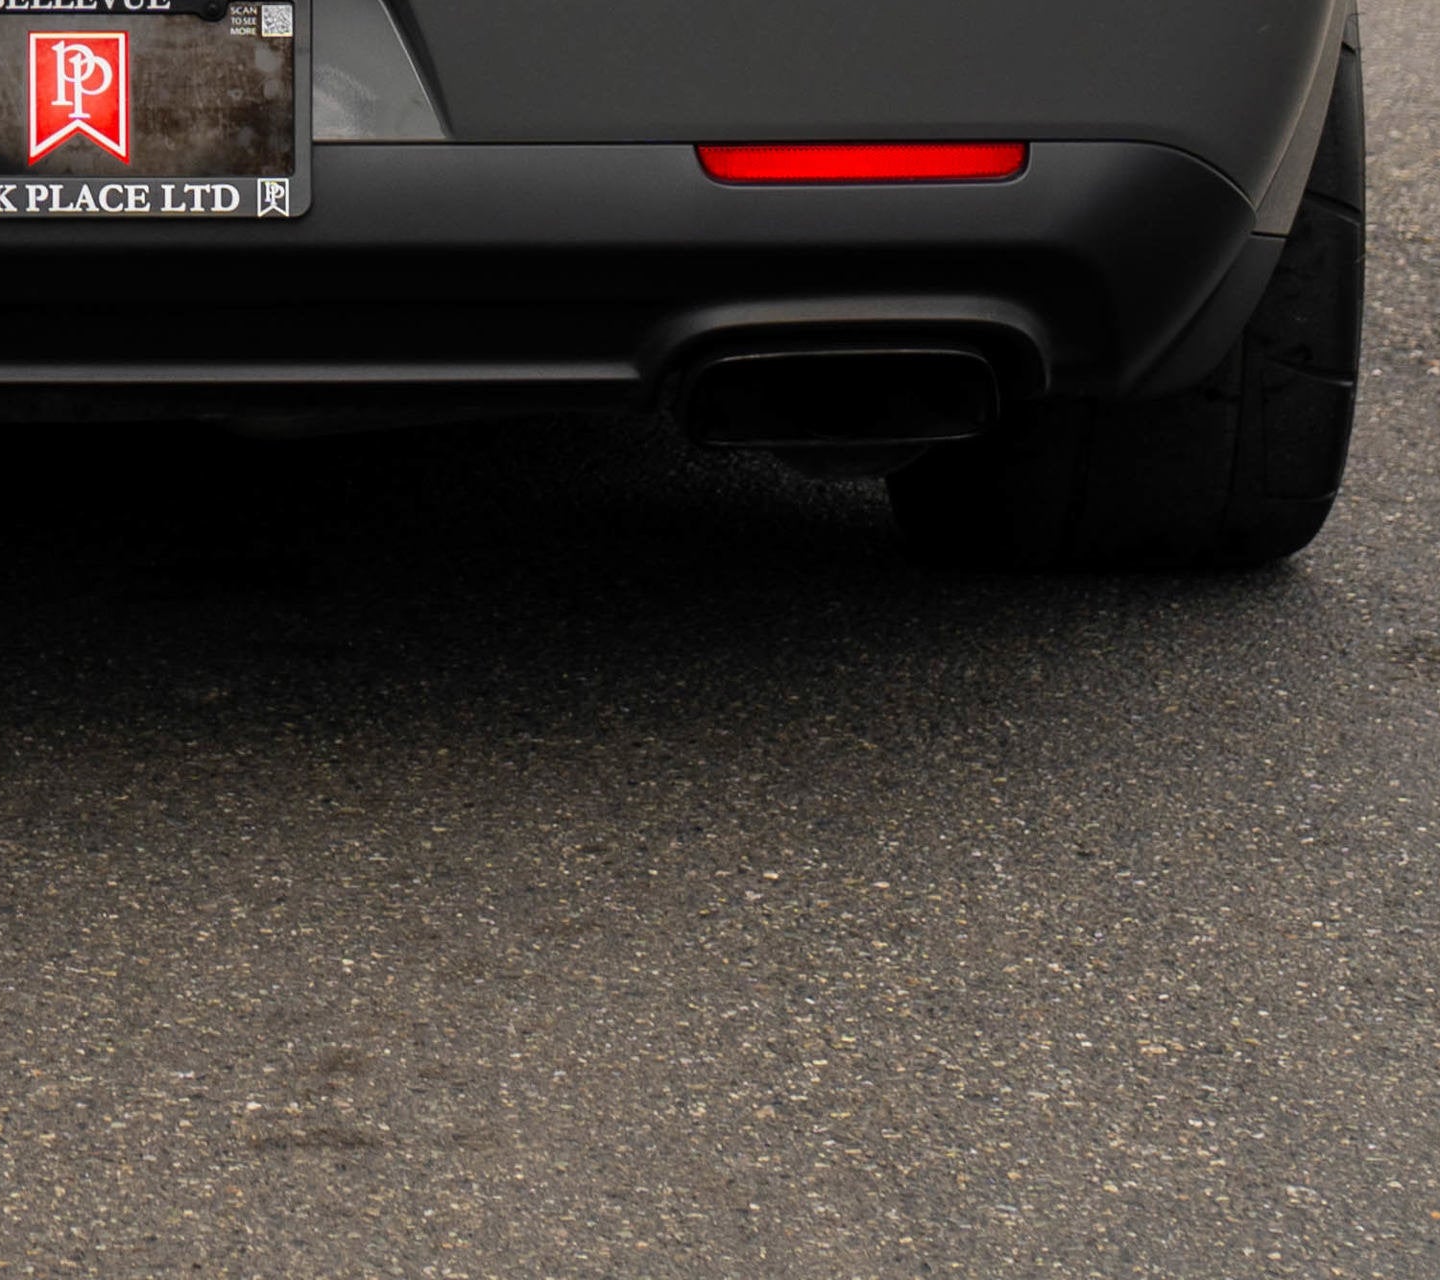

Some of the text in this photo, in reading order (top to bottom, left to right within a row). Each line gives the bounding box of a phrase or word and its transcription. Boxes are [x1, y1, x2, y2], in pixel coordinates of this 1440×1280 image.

[230, 5, 258, 15] SCAN
[231, 16, 242, 25] TO
[230, 27, 257, 36] MORE
[25, 183, 151, 212] PLACE
[160, 183, 240, 212] LTD
